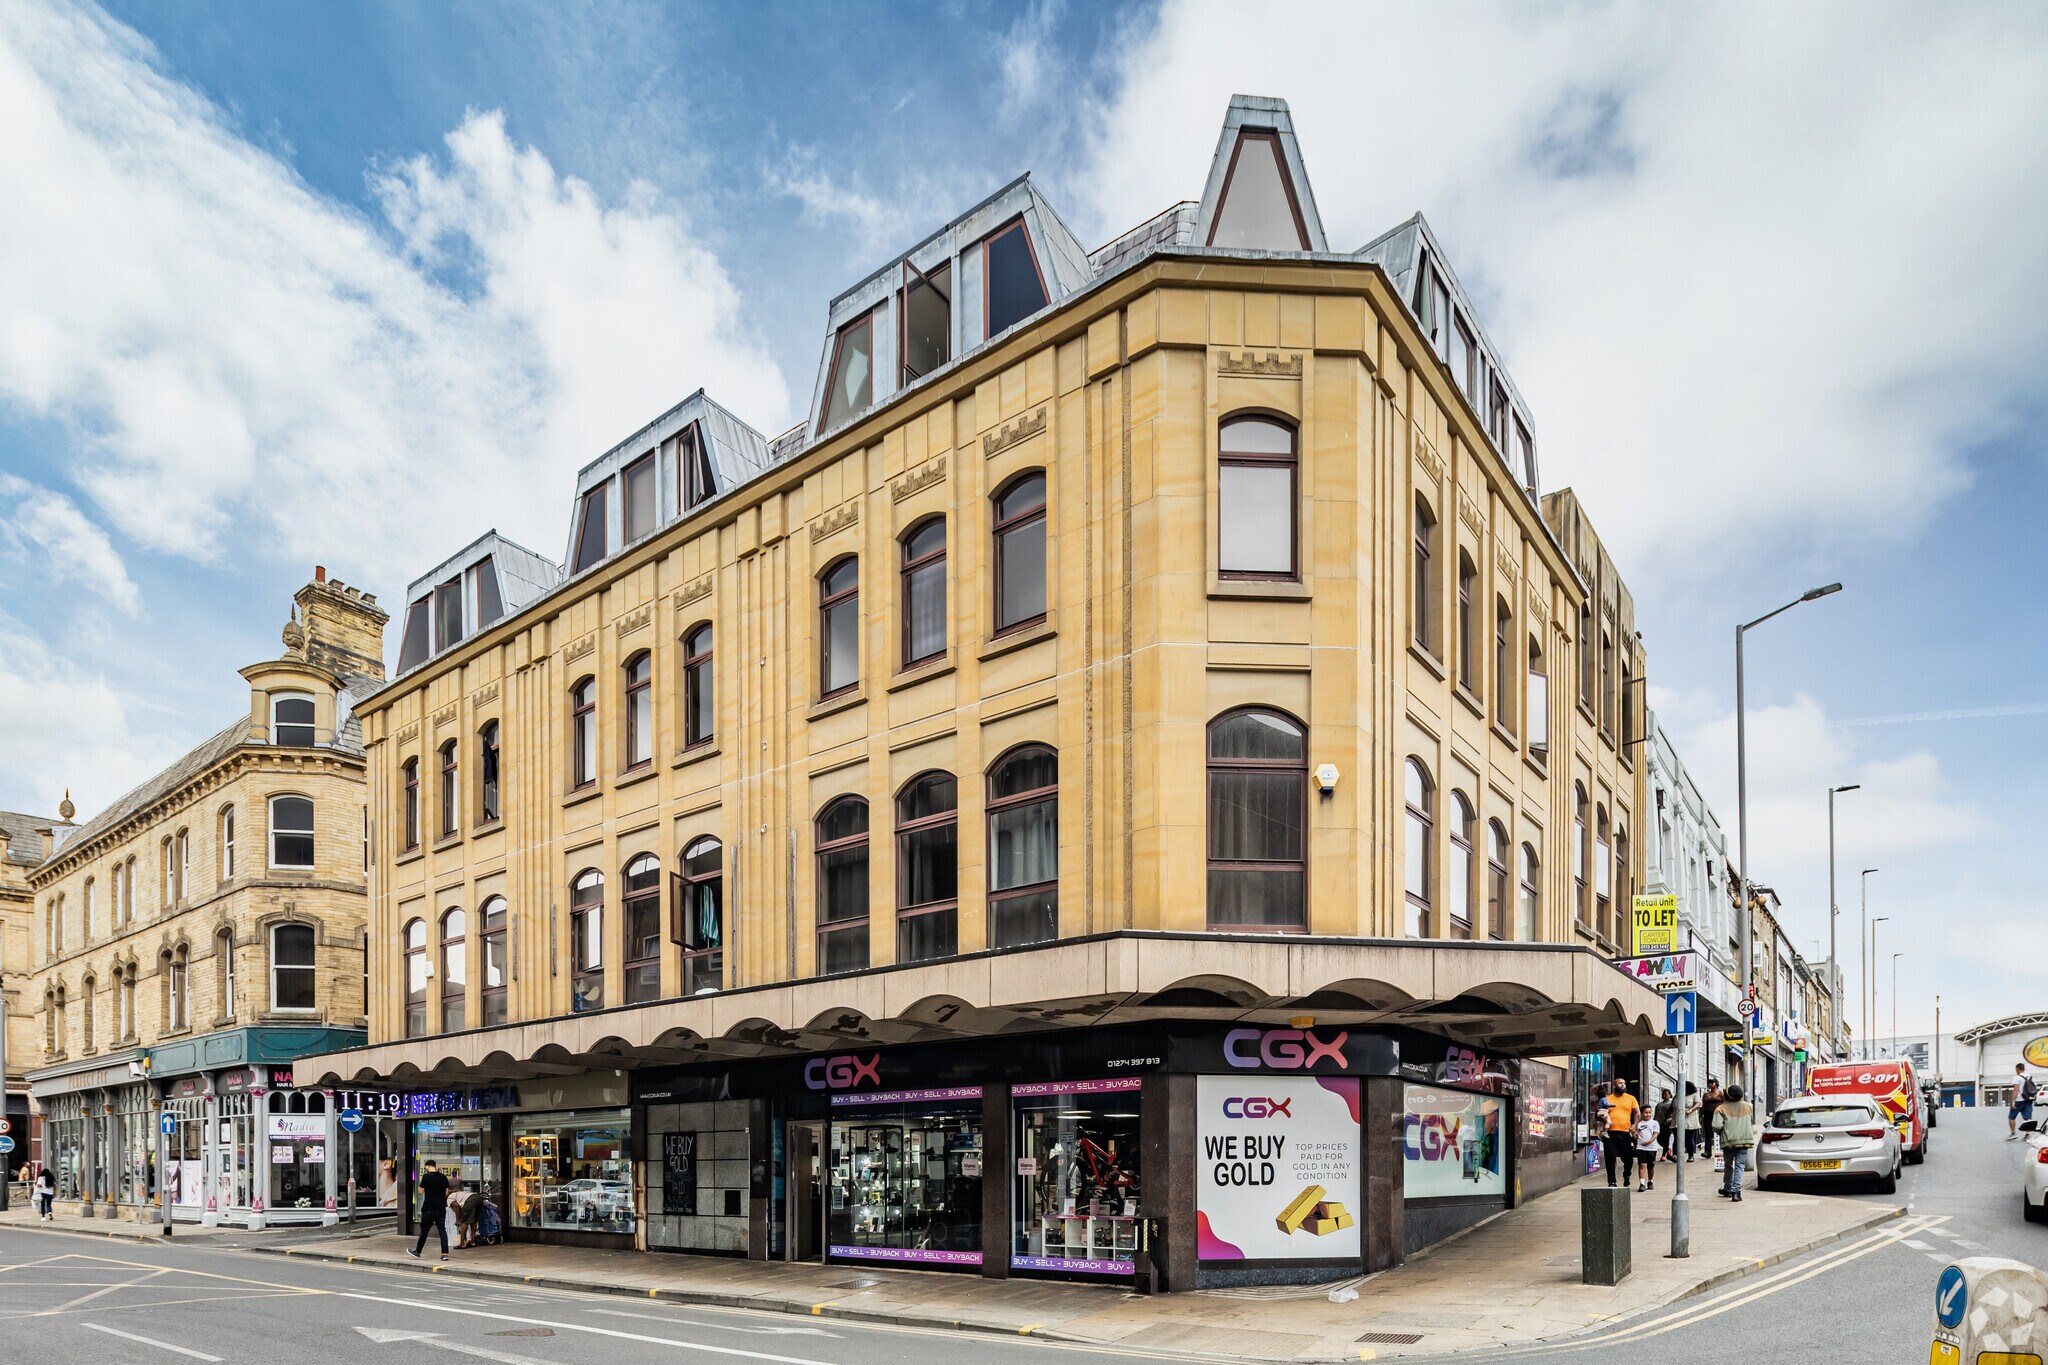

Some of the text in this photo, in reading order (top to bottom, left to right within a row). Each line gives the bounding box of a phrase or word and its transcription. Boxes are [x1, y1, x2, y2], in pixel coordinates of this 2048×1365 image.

[1636, 898, 1674, 907] Retail Unit
[1635, 909, 1675, 927] TO LET
[1637, 955, 1687, 979] AWAY
[1740, 1003, 1753, 1011] 20
[1223, 1029, 1348, 1070] CGX
[1107, 1057, 1161, 1068] 01274 397 813
[1445, 1046, 1486, 1086] CGX
[67, 1070, 108, 1089] PERFECT FIT
[804, 1053, 880, 1090] CGX
[832, 1095, 844, 1104] BUY
[850, 1094, 865, 1102] SELL
[871, 1093, 900, 1101] BUYBACK
[924, 1090, 941, 1098] SELL
[947, 1088, 981, 1097] BUYBACK
[1011, 1085, 1047, 1094] BUYBACK
[1053, 1084, 1069, 1092] BUY
[1077, 1082, 1097, 1090] SELL
[341, 1092, 401, 1112] 11:19
[1222, 1097, 1292, 1119] CGX
[283, 1119, 315, 1132] Nadia
[665, 1136, 694, 1155] WE BUY
[1403, 1113, 1460, 1162] CGX
[1205, 1135, 1285, 1160] WE BUY
[1295, 1143, 1348, 1151] TOP PRICES
[669, 1155, 689, 1172] GOLD
[1803, 1160, 1823, 1168] DS66
[1214, 1162, 1275, 1187] GOLD
[1296, 1172, 1348, 1180] CONDITION
[870, 1249, 900, 1257] BUYBACK
[904, 1250, 917, 1258] BUY
[947, 1253, 980, 1261] BUYBACK
[1013, 1257, 1028, 1265] BUY
[1035, 1259, 1055, 1267] SELL
[1063, 1260, 1101, 1269] BUYBACK
[1107, 1263, 1123, 1271] BUY
